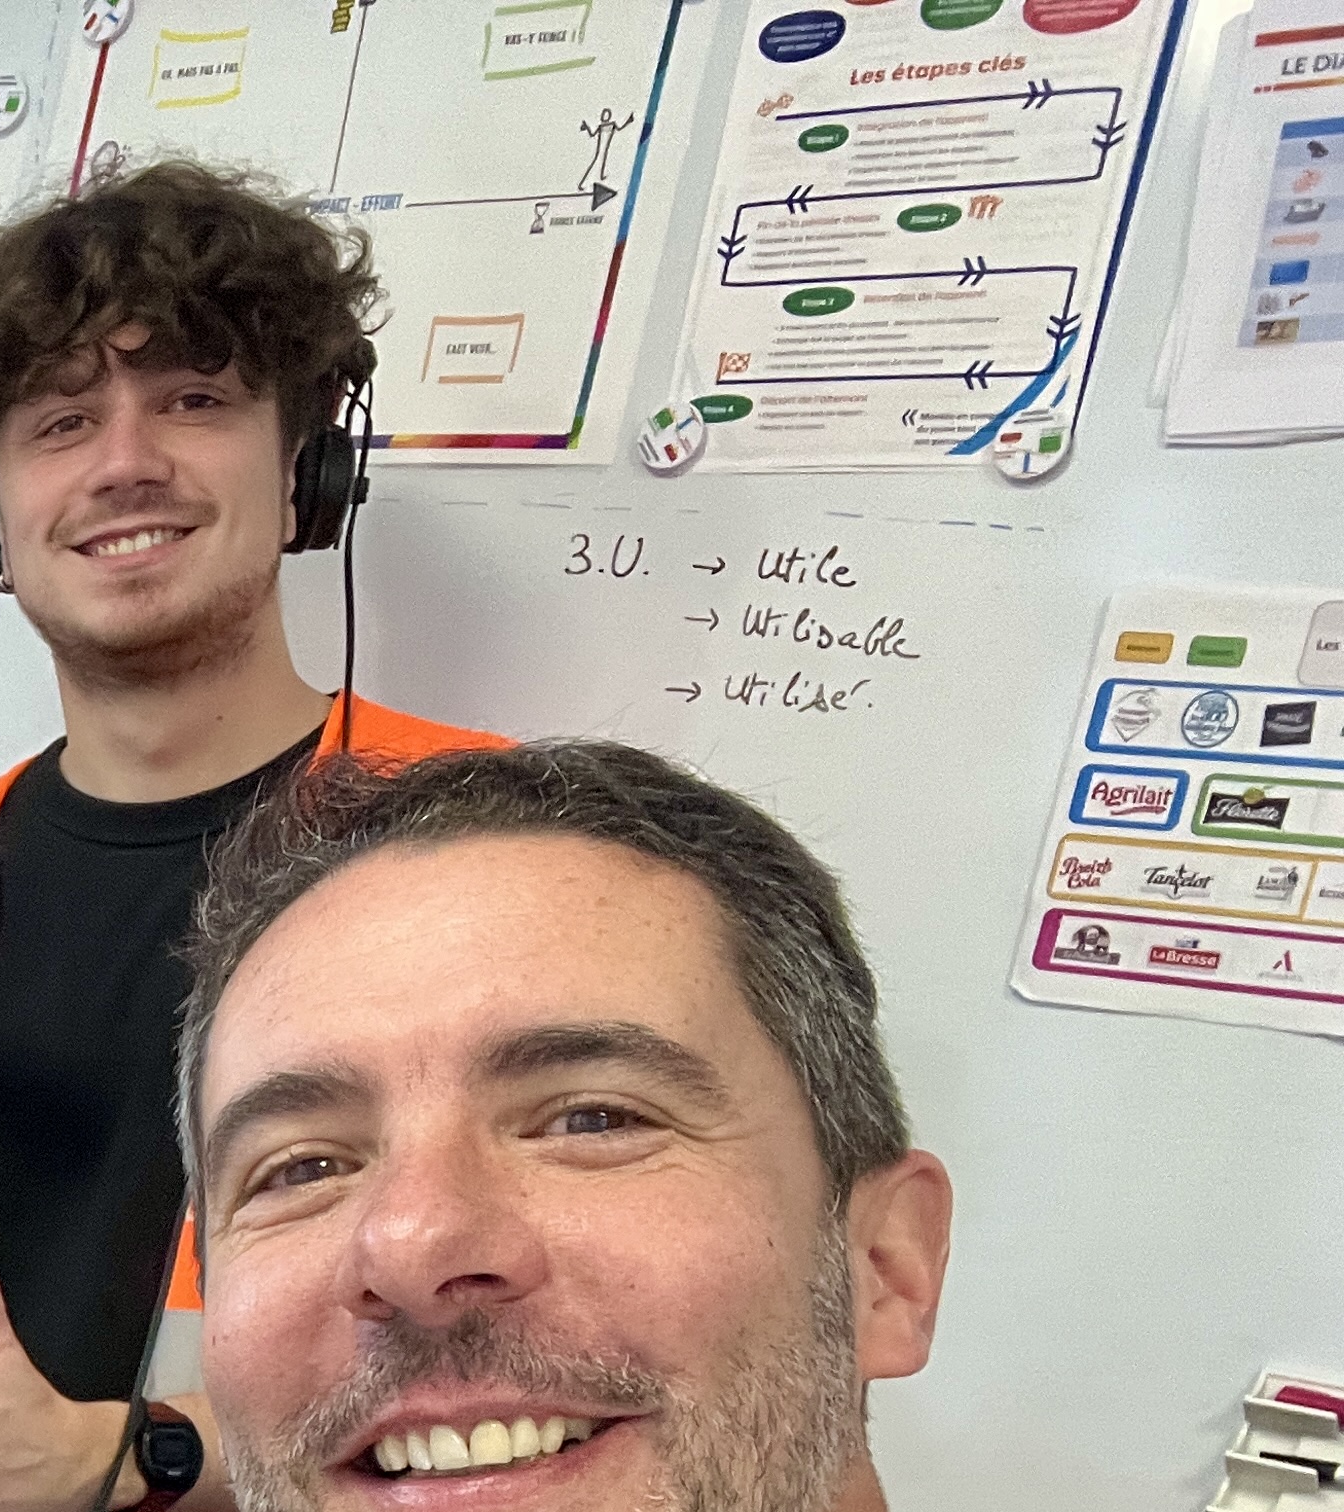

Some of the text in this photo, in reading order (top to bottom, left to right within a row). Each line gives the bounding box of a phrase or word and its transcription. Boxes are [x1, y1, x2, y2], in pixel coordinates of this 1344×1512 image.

[849, 53, 1029, 87] Les étapes clés
[1281, 56, 1308, 75] LE
[755, 545, 858, 588] Utile
[741, 603, 920, 659] Utilisable
[1091, 781, 1174, 807] Agrilait
